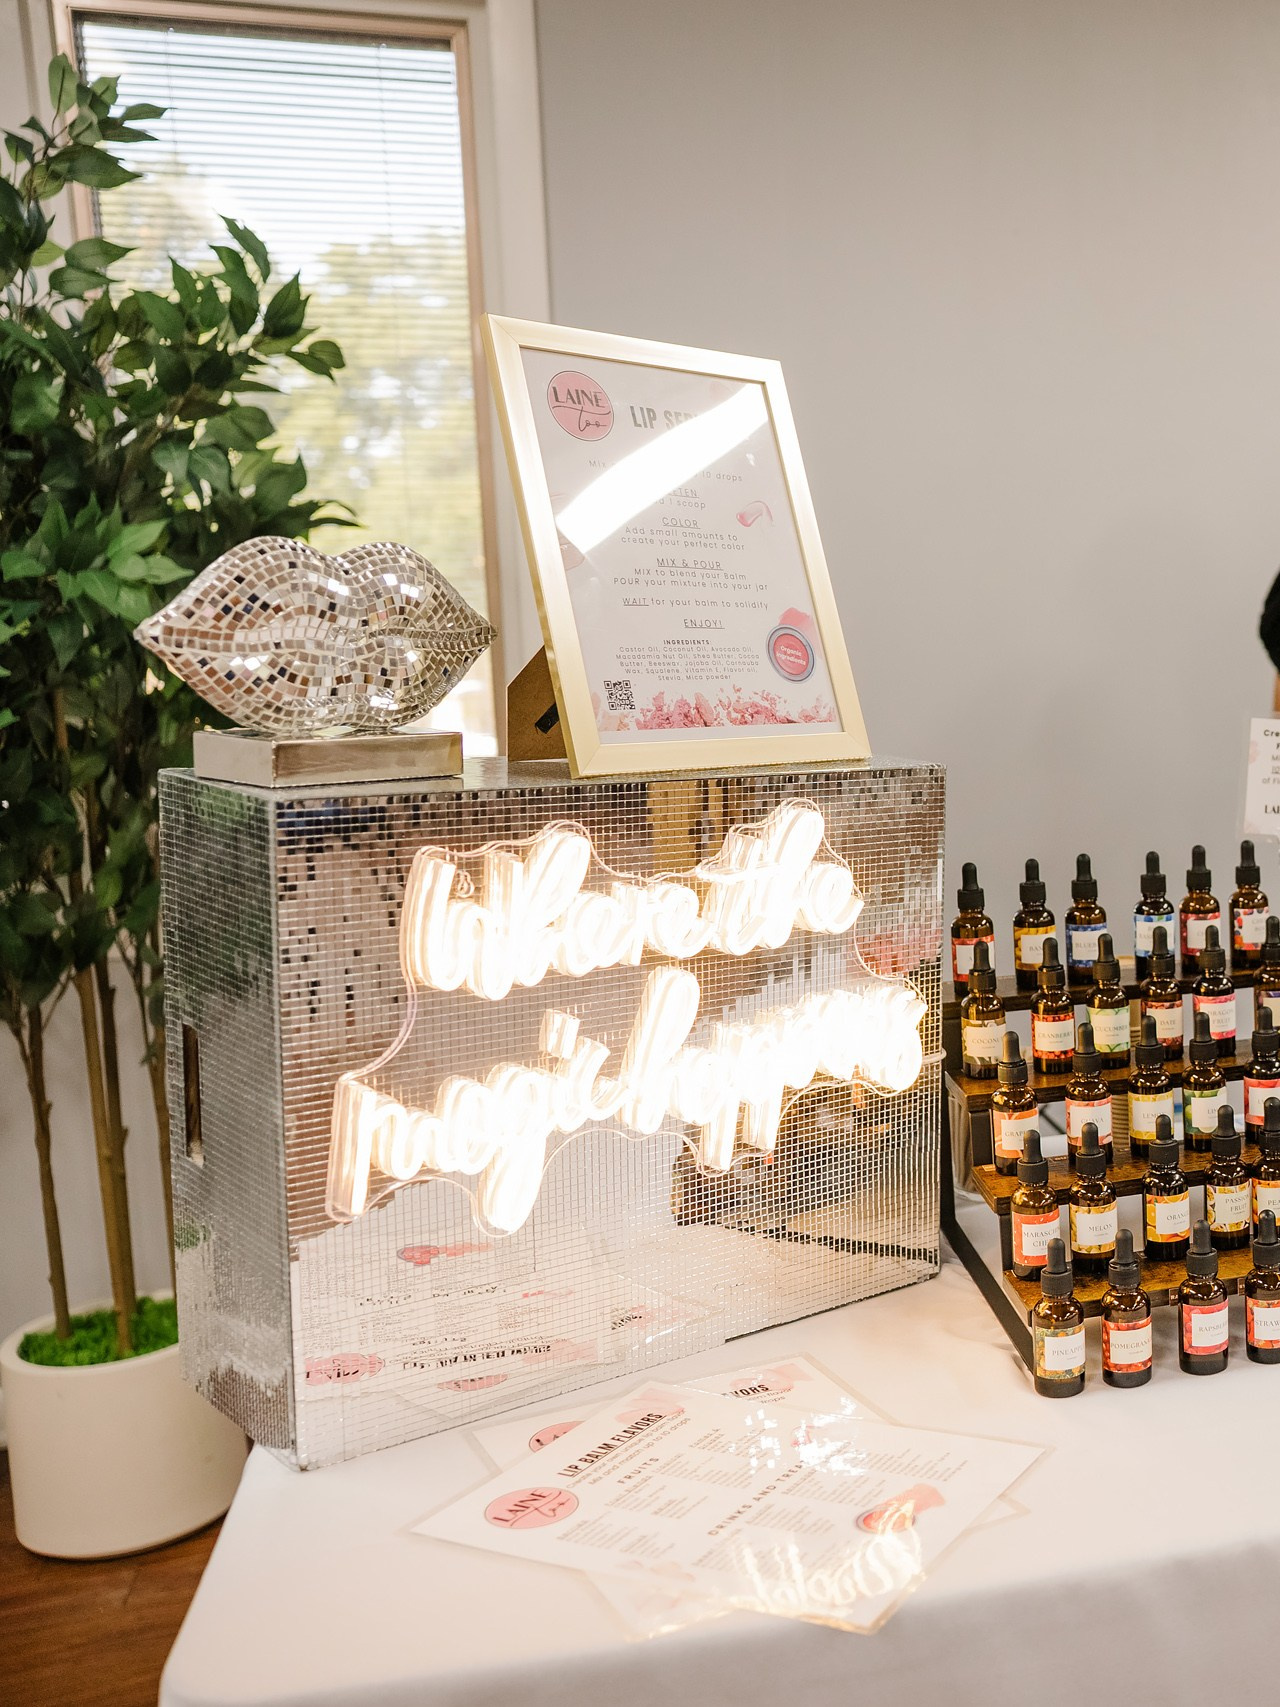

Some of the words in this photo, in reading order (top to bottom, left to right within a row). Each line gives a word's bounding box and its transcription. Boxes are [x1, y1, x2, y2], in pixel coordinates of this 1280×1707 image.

[552, 386, 606, 408] LAINE
[630, 405, 658, 429] LIP
[716, 472, 743, 483] drops
[677, 500, 707, 511] scoop
[662, 516, 700, 528] COLOR
[625, 526, 646, 535] Add
[650, 528, 678, 537] small
[682, 530, 725, 541] amounts
[728, 533, 738, 542] to
[621, 536, 655, 545] create
[659, 539, 680, 548] your
[684, 539, 718, 550] perfect
[721, 543, 746, 551] color
[656, 558, 677, 568] MIX
[682, 559, 690, 568] &
[694, 560, 722, 570] POUR
[634, 568, 651, 576] MIX
[655, 569, 666, 577] to
[670, 570, 697, 578] blend
[700, 572, 721, 581] your
[724, 573, 747, 581] Balm
[613, 577, 641, 586] POUR
[644, 579, 667, 588] your
[671, 579, 707, 588] mixture
[710, 581, 728, 589] into
[731, 583, 752, 592] your
[755, 584, 769, 593] jar
[622, 597, 648, 607] WAIT
[651, 597, 666, 606] for
[670, 599, 691, 608] your
[696, 599, 718, 608] balm
[722, 600, 732, 608] to
[683, 618, 724, 630] ENJOY!
[1262, 777, 1270, 785] of
[1159, 1019, 1176, 1027] DATE
[1088, 1223, 1113, 1233] MELON
[557, 1464, 582, 1477] LIP
[578, 1442, 617, 1464] BALM
[611, 1412, 663, 1443] FLAVORS
[617, 1457, 659, 1484] FRUITS
[493, 1488, 547, 1522] LAINE
[707, 1503, 752, 1536] DRINKS
[752, 1484, 777, 1502] AND
